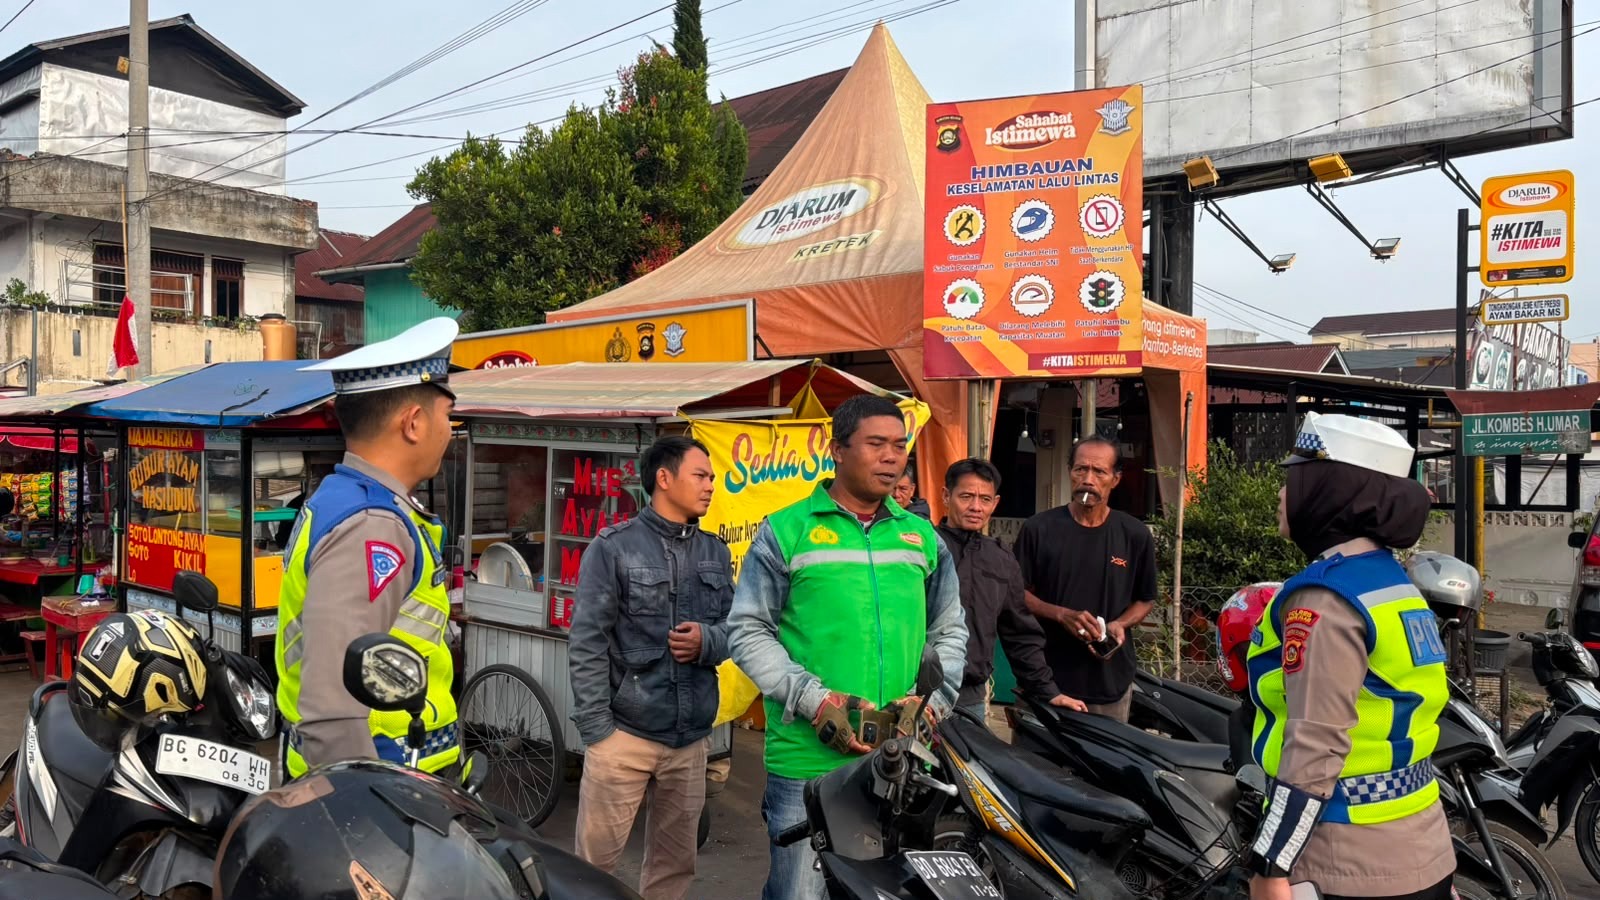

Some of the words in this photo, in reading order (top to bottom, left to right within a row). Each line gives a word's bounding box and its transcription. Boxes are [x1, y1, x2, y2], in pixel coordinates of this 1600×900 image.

[1016, 111, 1073, 129] Sahabat
[985, 123, 1077, 146] Istimewa
[971, 158, 1093, 180] HIMBAUAN
[947, 179, 1035, 196] KESELAMATAN
[1039, 177, 1070, 189] LALU
[1074, 172, 1119, 187] LINTAS
[1508, 186, 1551, 198] DJARUM
[755, 189, 857, 231] DJARUM
[771, 211, 843, 236] Istimewa
[1491, 220, 1544, 241] #KITA
[793, 231, 873, 259] KRETEK
[1004, 249, 1037, 258] Gunakan
[1038, 247, 1058, 256] Helm
[1497, 236, 1562, 252] ISTIMEWA
[947, 253, 980, 261] Gunakan
[1004, 259, 1044, 268] Berstandar
[1046, 258, 1059, 266] SNI
[1079, 257, 1092, 265] Saat
[1092, 255, 1124, 263] Berkendara
[933, 264, 956, 273] Sabuk
[956, 262, 995, 272] Pengaman
[1075, 319, 1101, 327] Patuhi
[1102, 318, 1131, 327] Rambu
[1488, 310, 1512, 320] AYAM
[1514, 308, 1546, 319] BAKAR
[1547, 307, 1561, 317] MS
[941, 323, 965, 332] Patuhi
[965, 323, 986, 331] Batas
[999, 322, 1030, 331] Dilarang
[1031, 320, 1065, 329] Melebihi
[1082, 330, 1098, 338] Lalu
[1099, 329, 1124, 338] Lintas
[1163, 320, 1196, 339] Istimewa
[944, 334, 982, 343] Kecepatan
[999, 331, 1034, 341] Kapasitas
[1035, 330, 1065, 339] Muatan
[1042, 353, 1127, 367] #KITAISTIMEWA
[1471, 417, 1534, 434] JL.KOMBES
[1536, 414, 1581, 434] H.UMAR
[129, 450, 165, 493] BUBUR
[167, 450, 199, 488] AYAM
[725, 433, 801, 494] Sedia
[573, 456, 623, 498] MIE
[128, 523, 148, 543] SOTO
[148, 526, 184, 548] LONTONG
[183, 532, 207, 554] AYAM
[718, 520, 743, 545] Bubur
[128, 541, 149, 561] SOTO
[173, 549, 202, 573] KIKIL
[163, 737, 187, 755] BG
[197, 743, 239, 767] 6204
[249, 756, 268, 777] WH
[912, 856, 938, 880] BD
[932, 856, 967, 879] 6849
